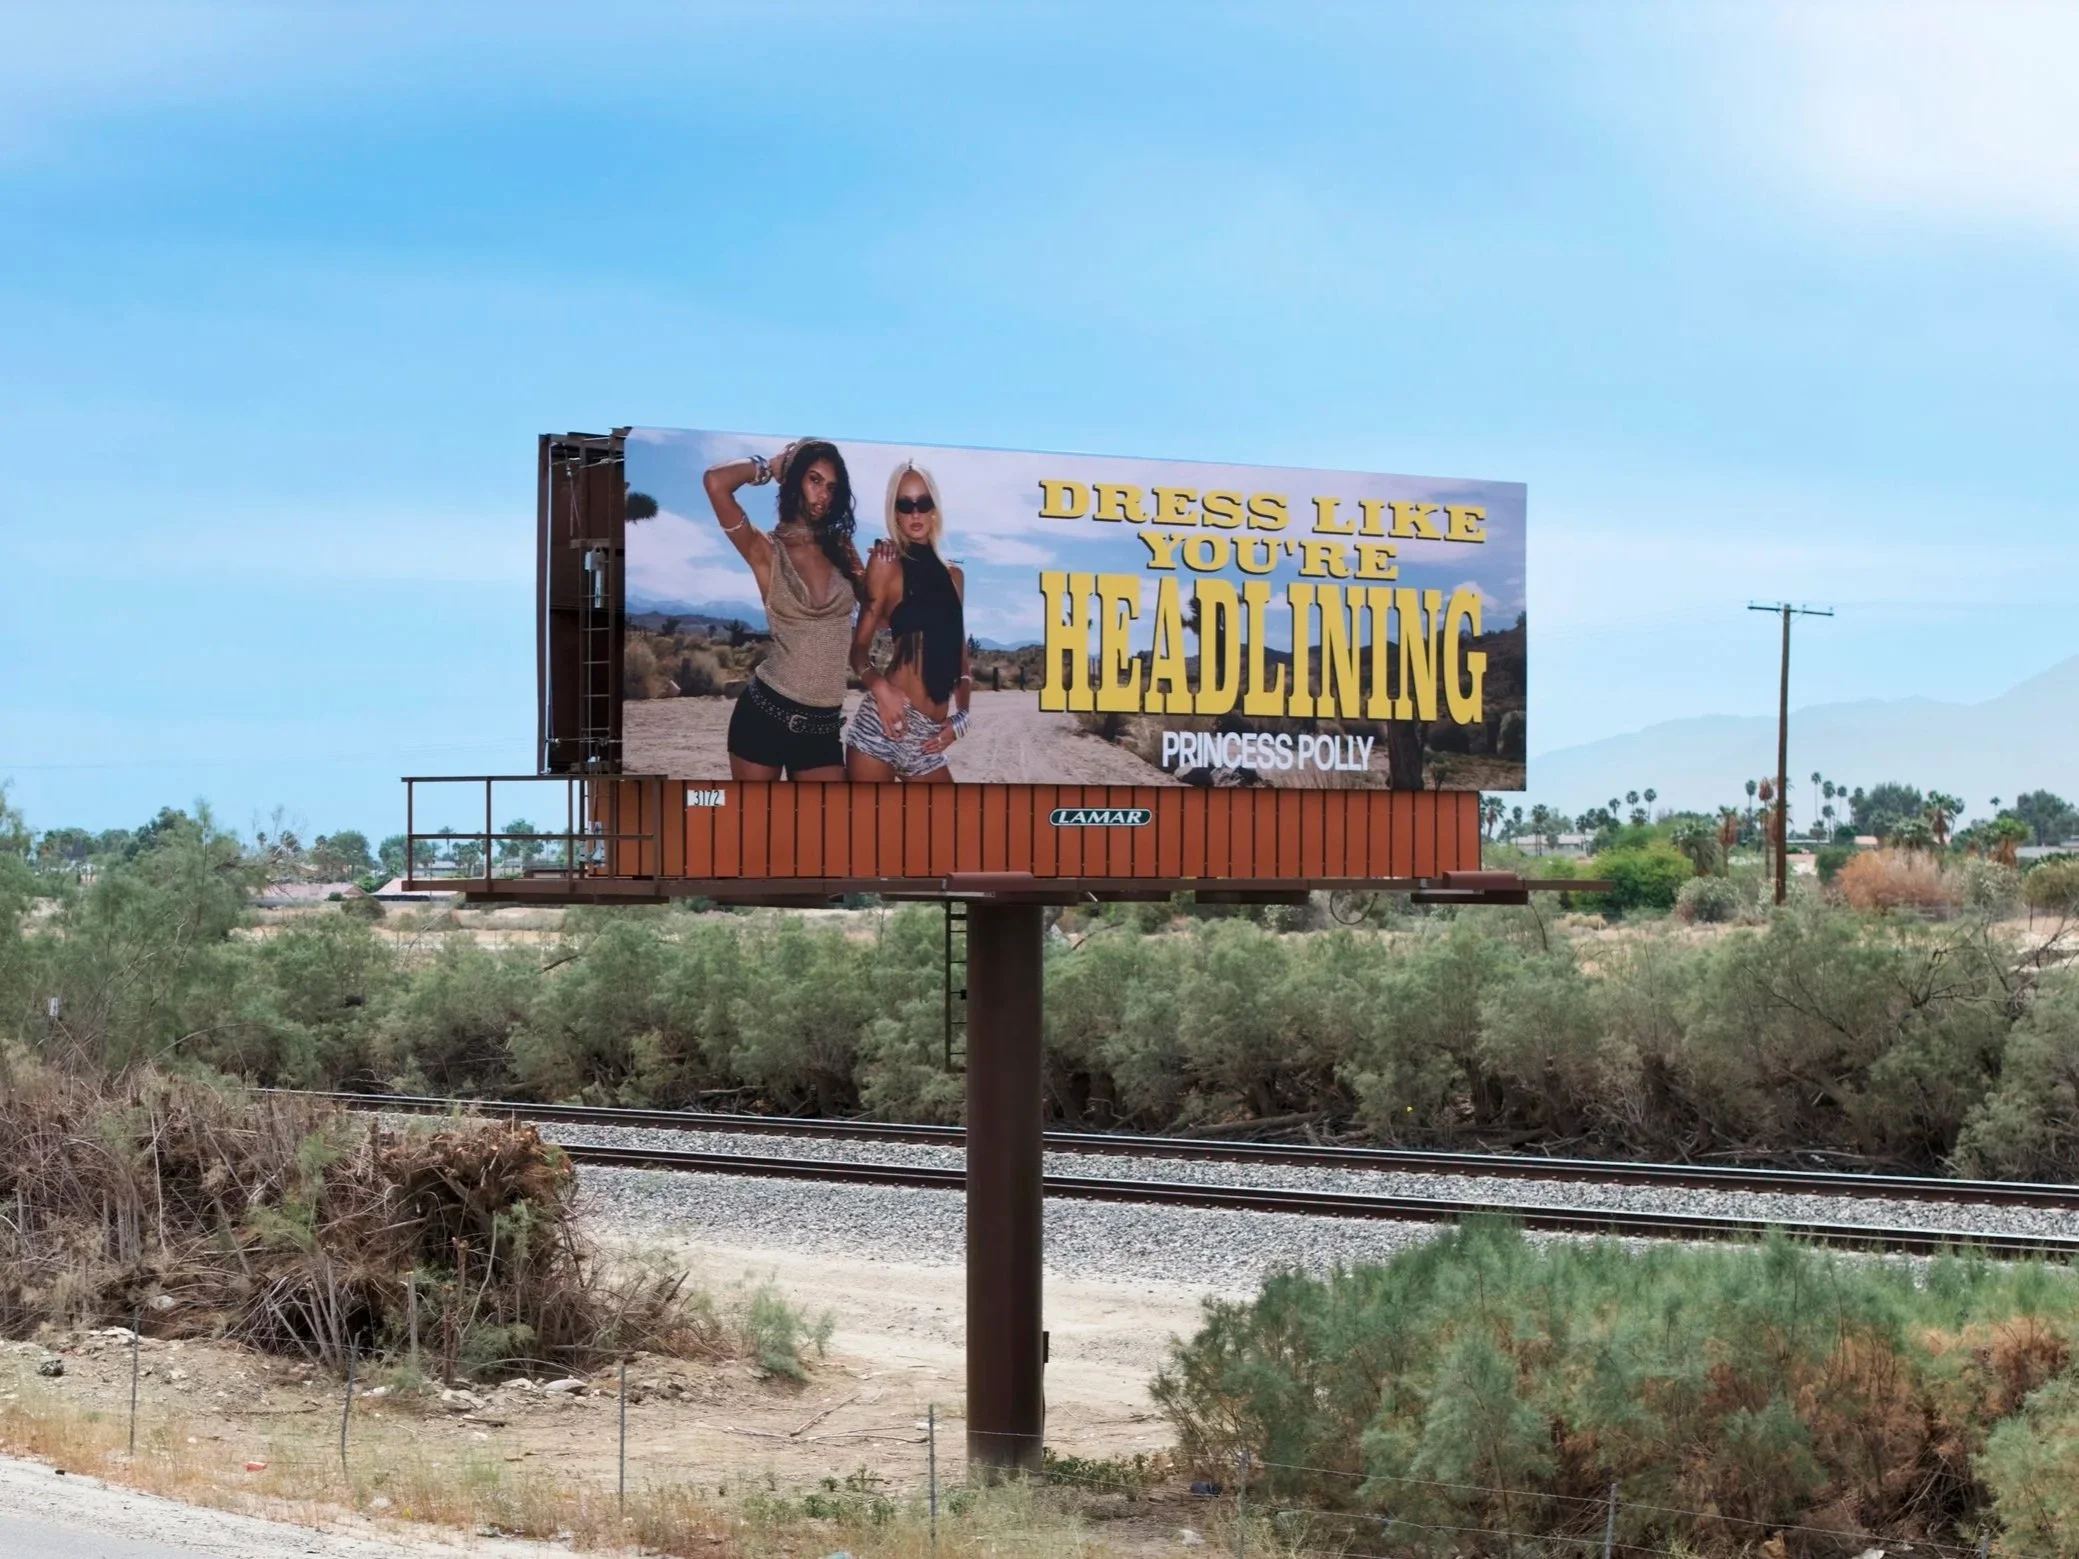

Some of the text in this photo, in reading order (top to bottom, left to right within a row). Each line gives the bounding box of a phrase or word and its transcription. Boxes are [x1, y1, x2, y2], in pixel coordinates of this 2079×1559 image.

[1039, 479, 1488, 543] DRESS LIKE
[1139, 531, 1398, 580] YOU'RE
[1039, 571, 1488, 725] HEADLINING
[1162, 731, 1375, 772] PRINCESS POLLY
[694, 790, 720, 806] 3172
[1058, 811, 1142, 824] LAMAR
